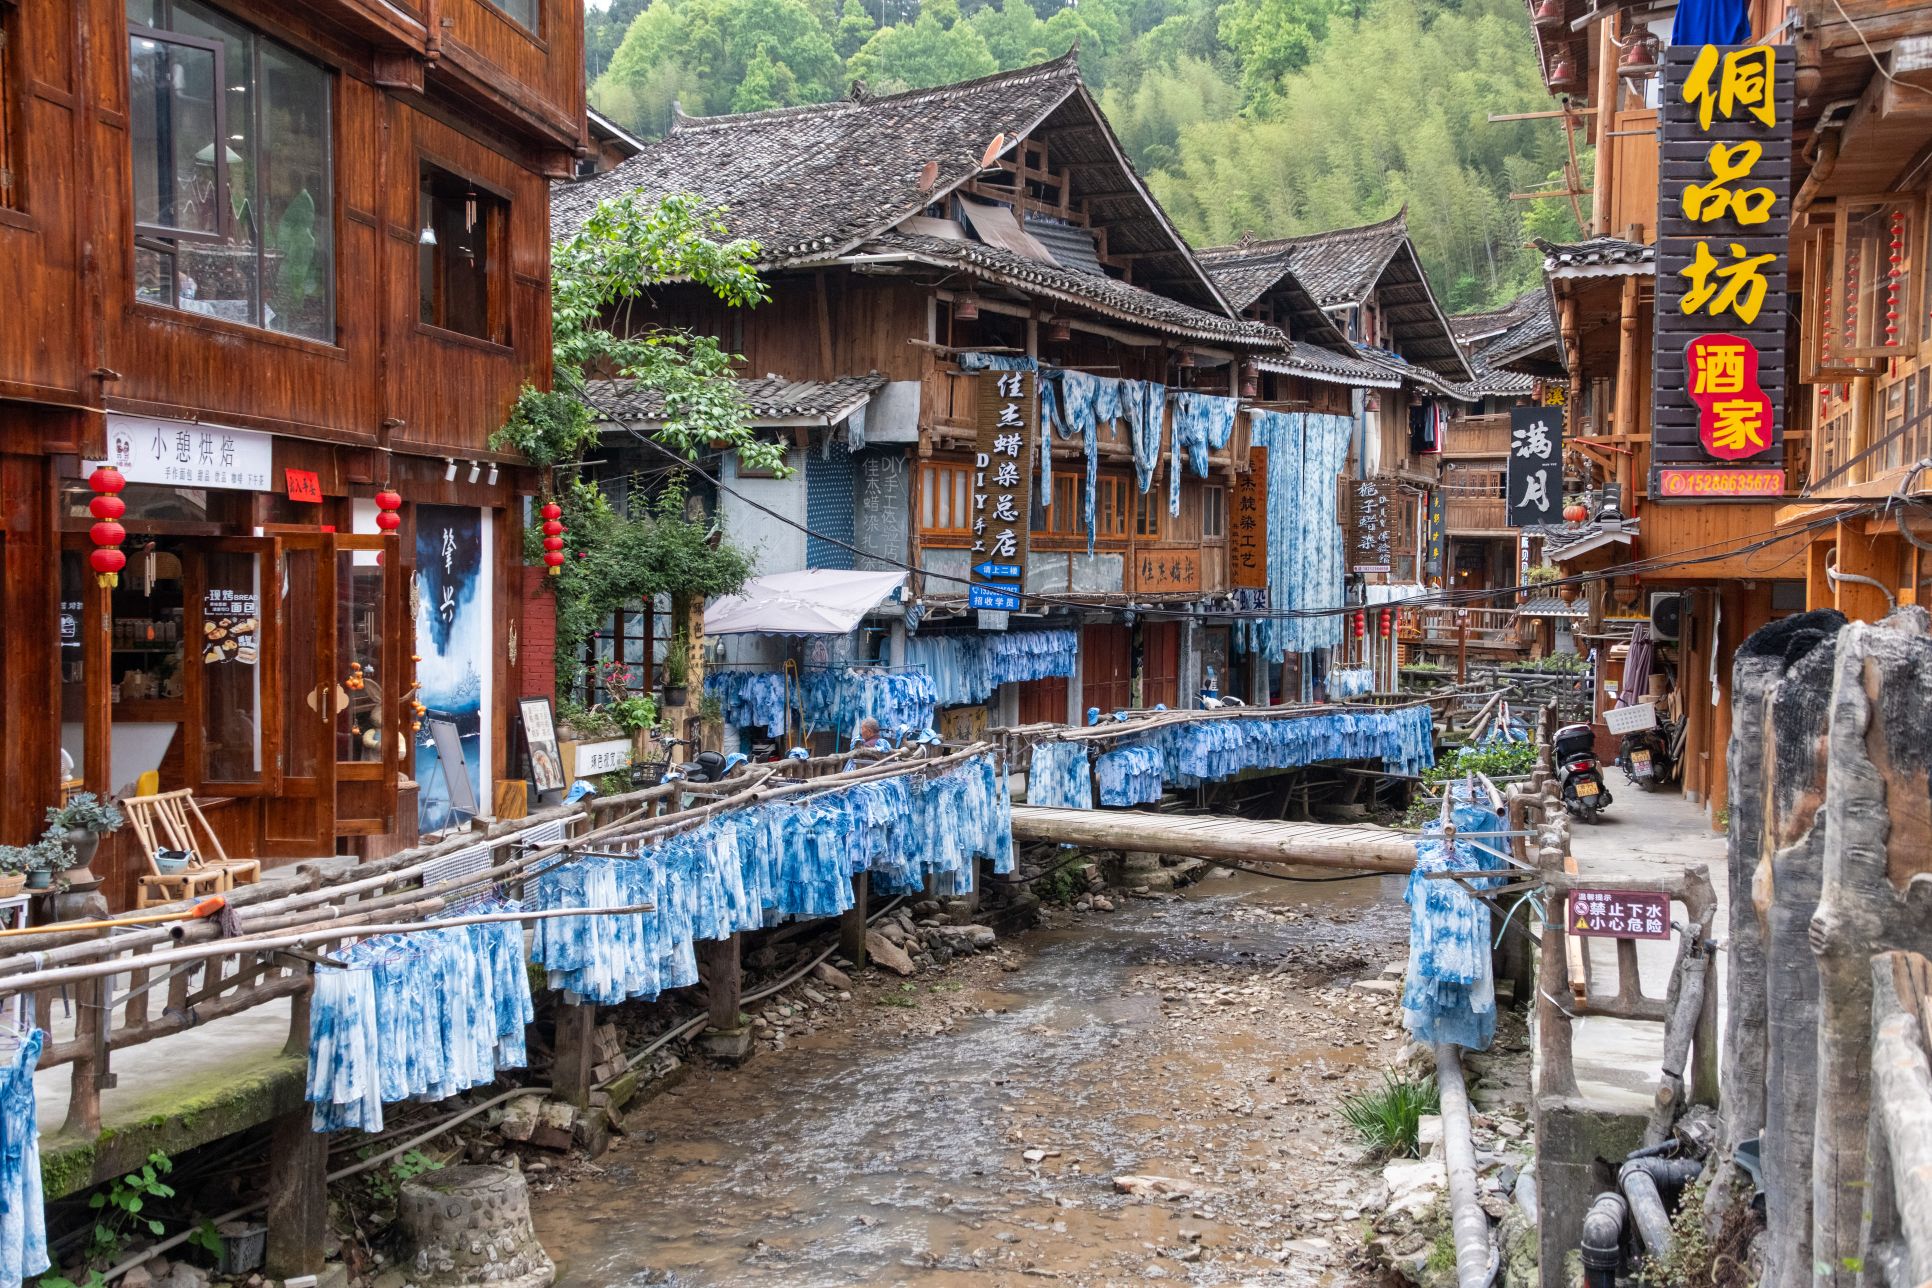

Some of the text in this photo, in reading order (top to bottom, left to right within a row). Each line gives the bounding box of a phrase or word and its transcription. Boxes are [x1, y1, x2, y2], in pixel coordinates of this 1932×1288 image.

[1680, 43, 1777, 325] 侗品坊
[1693, 344, 1765, 451] 酒家
[151, 427, 236, 468] 小憩烘焙
[991, 371, 1025, 557] 佳杰蜡染总店
[1511, 420, 1552, 513] 满月
[1687, 474, 1780, 492] 15286635673
[971, 453, 990, 552] DIY手工
[983, 565, 1018, 575] 请上二楼
[231, 602, 255, 613] 面包
[974, 596, 1015, 608] 招收学员
[1578, 892, 1612, 902] 温馨提示
[1589, 901, 1663, 919] 禁止下水
[1590, 916, 1663, 933] 小心危险
